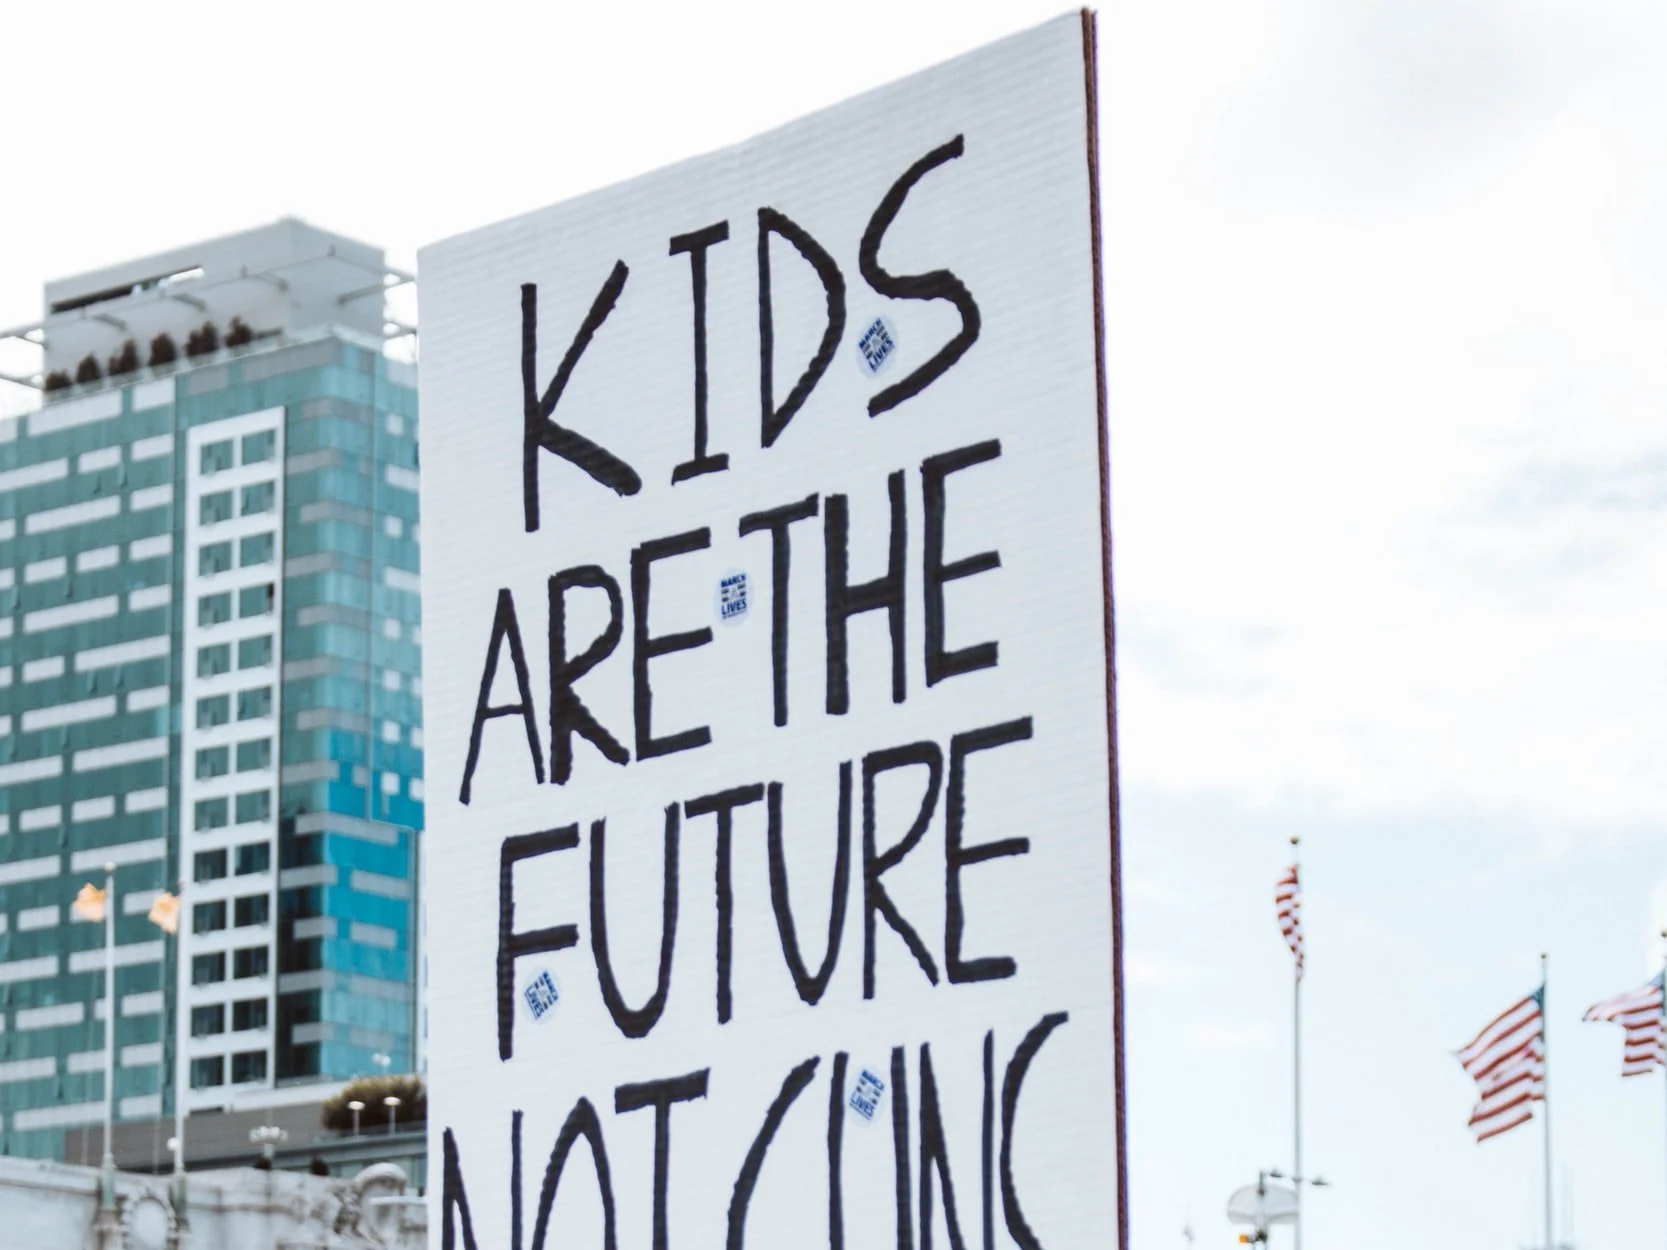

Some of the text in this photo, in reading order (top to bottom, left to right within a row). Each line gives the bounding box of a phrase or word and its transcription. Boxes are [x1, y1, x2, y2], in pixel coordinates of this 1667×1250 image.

[520, 133, 982, 532] KIDS
[460, 439, 1002, 805] ARE THE
[722, 598, 748, 616] LIVES
[497, 716, 1034, 1062] FUTURE
